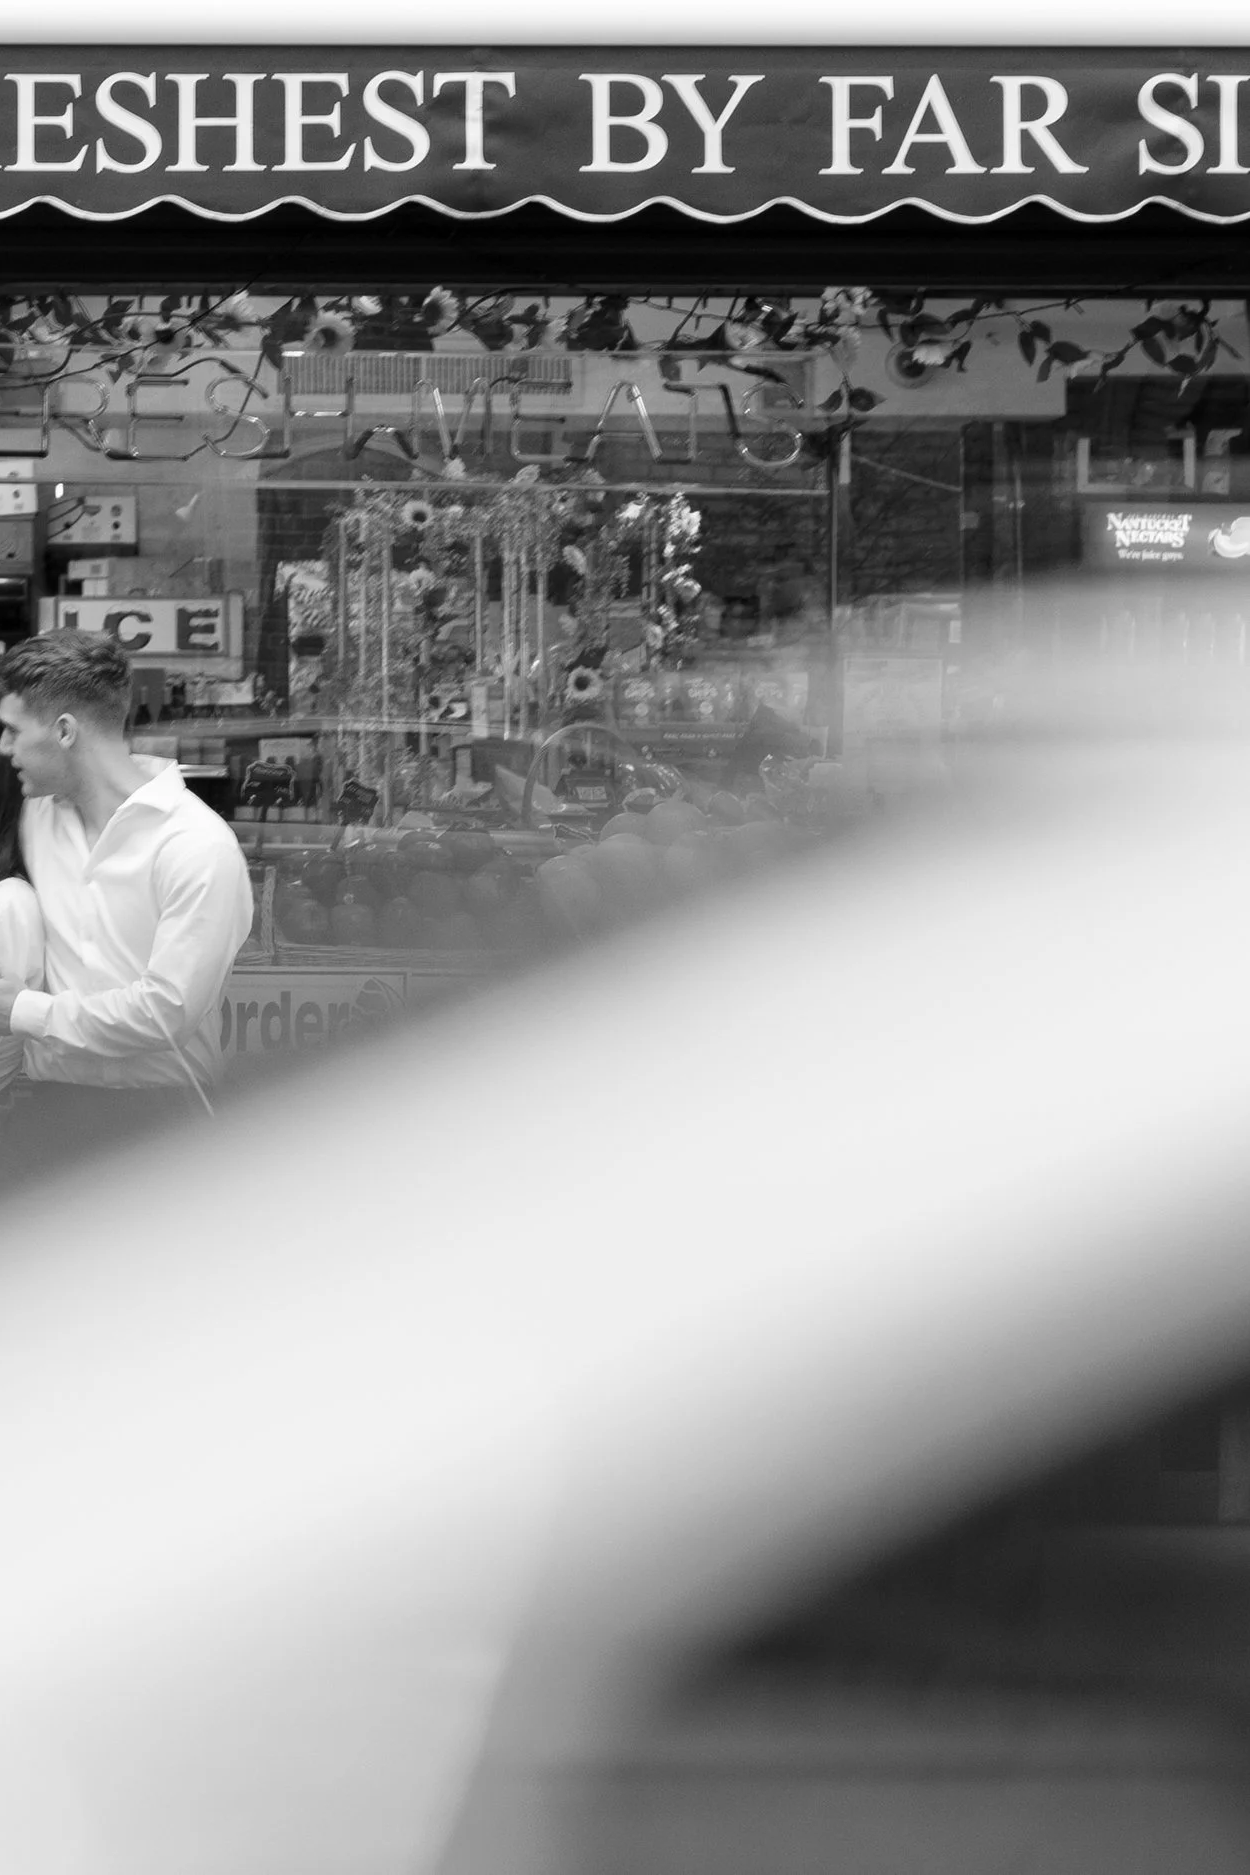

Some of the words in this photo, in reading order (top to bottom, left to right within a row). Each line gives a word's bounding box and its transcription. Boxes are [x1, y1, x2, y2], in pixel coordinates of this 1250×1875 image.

[578, 73, 765, 173] BY
[818, 73, 1089, 174] FAR
[1106, 513, 1192, 532] NANTUCKET
[1115, 531, 1185, 548] NECTARS
